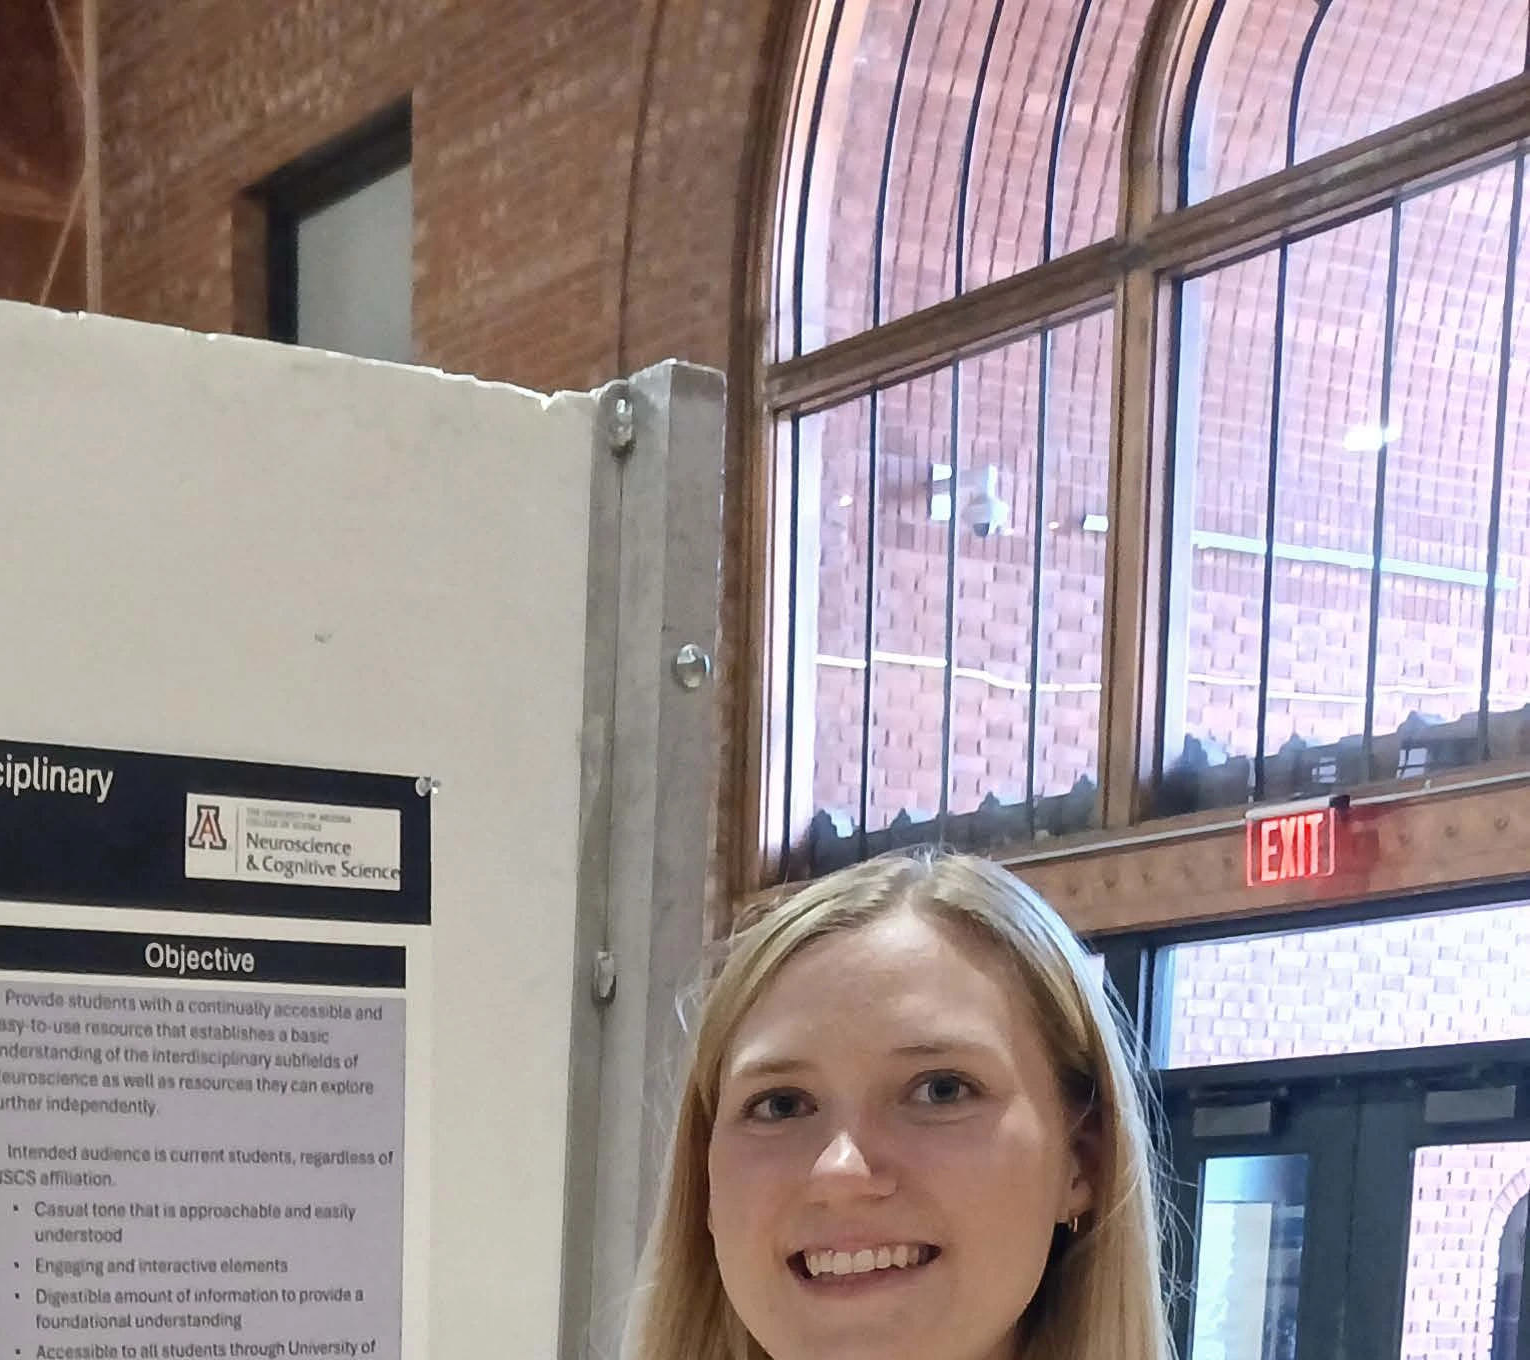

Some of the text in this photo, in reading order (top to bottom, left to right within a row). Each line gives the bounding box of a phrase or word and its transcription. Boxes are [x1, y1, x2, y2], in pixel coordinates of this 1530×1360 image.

[245, 832, 352, 861] Neuroscience
[1260, 812, 1323, 881] EXIT
[245, 852, 403, 887] & Cognitive Science
[144, 942, 255, 973] Objective
[4, 988, 383, 1021] Provide students with a continually accessible and
[84, 1021, 153, 1038] resource
[155, 1021, 187, 1039] that
[189, 1024, 276, 1042] establishes
[277, 1028, 288, 1043] a
[290, 1026, 329, 1044] basic
[104, 1044, 121, 1063] of
[122, 1046, 149, 1063] the
[151, 1047, 272, 1070] interdisciplinary
[273, 1051, 341, 1069] subfields
[342, 1052, 359, 1069] of
[101, 1071, 120, 1088] as
[122, 1071, 154, 1088] well
[156, 1075, 176, 1089] as
[178, 1076, 253, 1092] resources
[255, 1075, 288, 1096] they
[289, 1079, 318, 1093] can
[320, 1079, 374, 1096] explore
